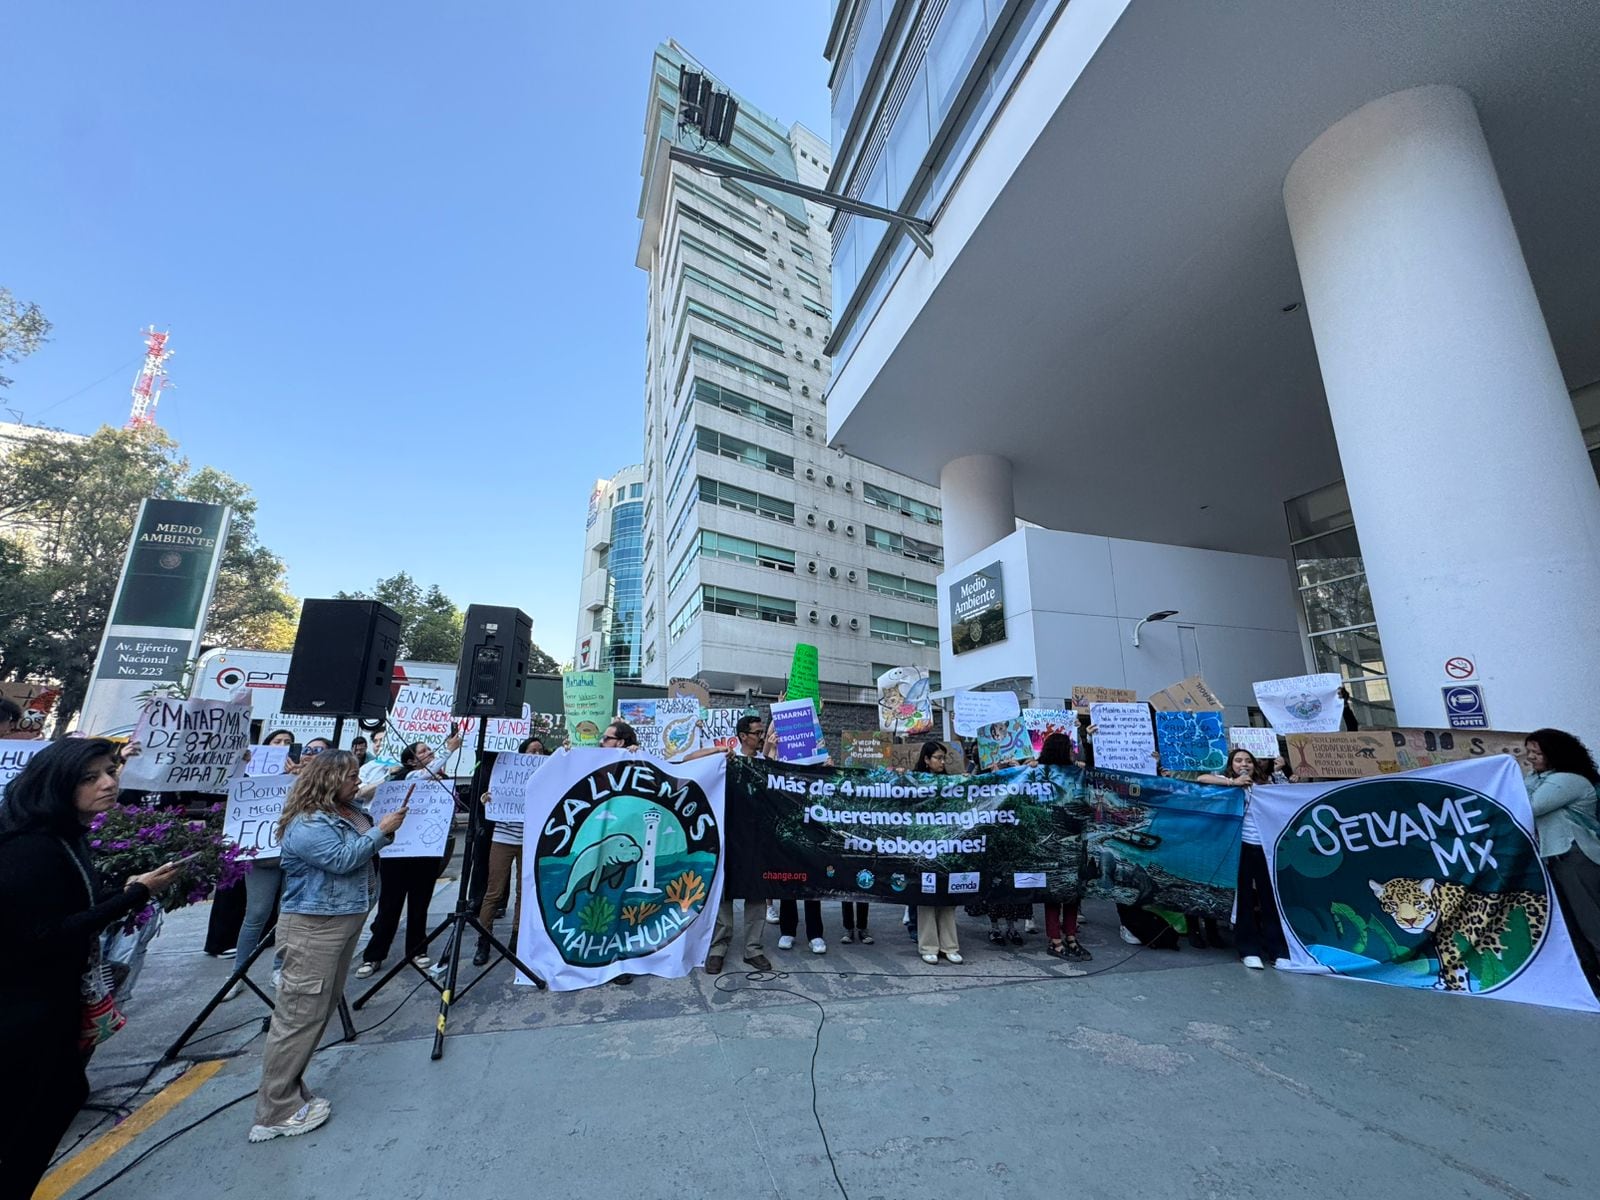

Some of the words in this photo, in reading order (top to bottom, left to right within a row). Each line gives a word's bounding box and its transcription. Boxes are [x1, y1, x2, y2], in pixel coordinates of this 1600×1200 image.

[156, 523, 202, 536] MEDIO
[139, 532, 215, 547] AMBIENTE
[960, 577, 987, 599] Medio
[955, 588, 996, 615] Ambiente
[115, 642, 132, 652] Av.
[136, 642, 178, 655] Ejército
[118, 653, 169, 664] Nacional
[118, 665, 138, 676] No.
[140, 666, 163, 676] 223
[397, 689, 418, 703] EN
[393, 706, 408, 719] NO
[773, 709, 811, 721] SEMARNAT
[397, 720, 448, 733] TOBOGANES
[497, 720, 529, 735] VENDE
[147, 729, 180, 748] DE
[185, 731, 221, 753] 870
[391, 731, 443, 744] QUEREMOS
[787, 741, 806, 749] FINAL
[155, 752, 176, 765] ES
[181, 751, 235, 766] SUFICIENTE
[166, 766, 211, 784] PARA
[767, 774, 806, 793] Más
[809, 780, 835, 796] de
[840, 781, 854, 797] 4
[856, 782, 937, 799] millones
[940, 782, 965, 799] de
[967, 782, 1052, 803] personas
[249, 803, 282, 815] MEGA
[544, 766, 714, 854] SALVEMOS
[803, 806, 913, 827] ¡Queremos
[915, 806, 1020, 829] manglares,
[1296, 794, 1490, 856] SELVAME
[844, 836, 873, 851] no
[876, 835, 986, 860] toboganes!
[1430, 837, 1498, 877] MX
[763, 870, 808, 882] change.org
[951, 880, 977, 890] cemda
[551, 907, 691, 960] MAHAHUAL
